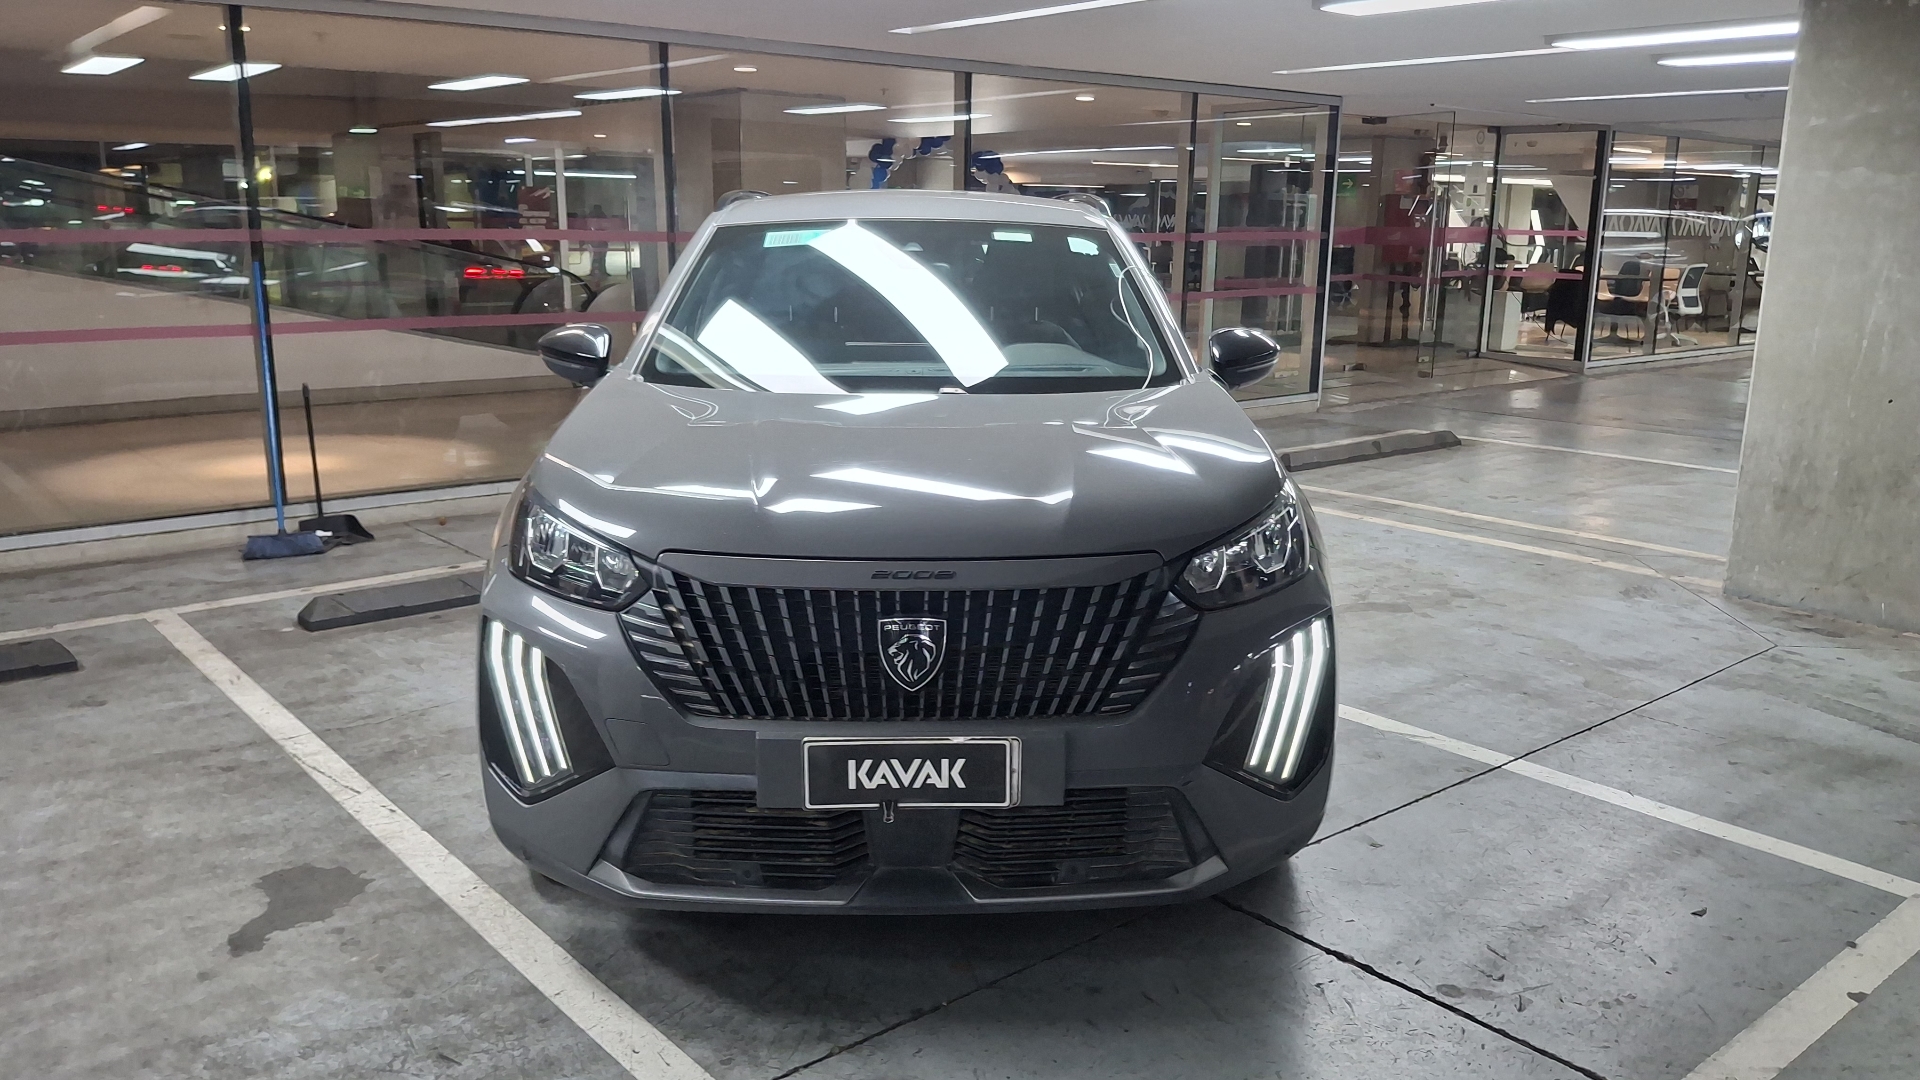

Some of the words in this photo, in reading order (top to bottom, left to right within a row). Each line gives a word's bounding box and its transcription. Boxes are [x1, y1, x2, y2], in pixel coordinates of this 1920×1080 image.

[871, 570, 957, 580] 2008
[883, 623, 941, 632] PEUGEOT
[847, 758, 967, 790] KAVAK
